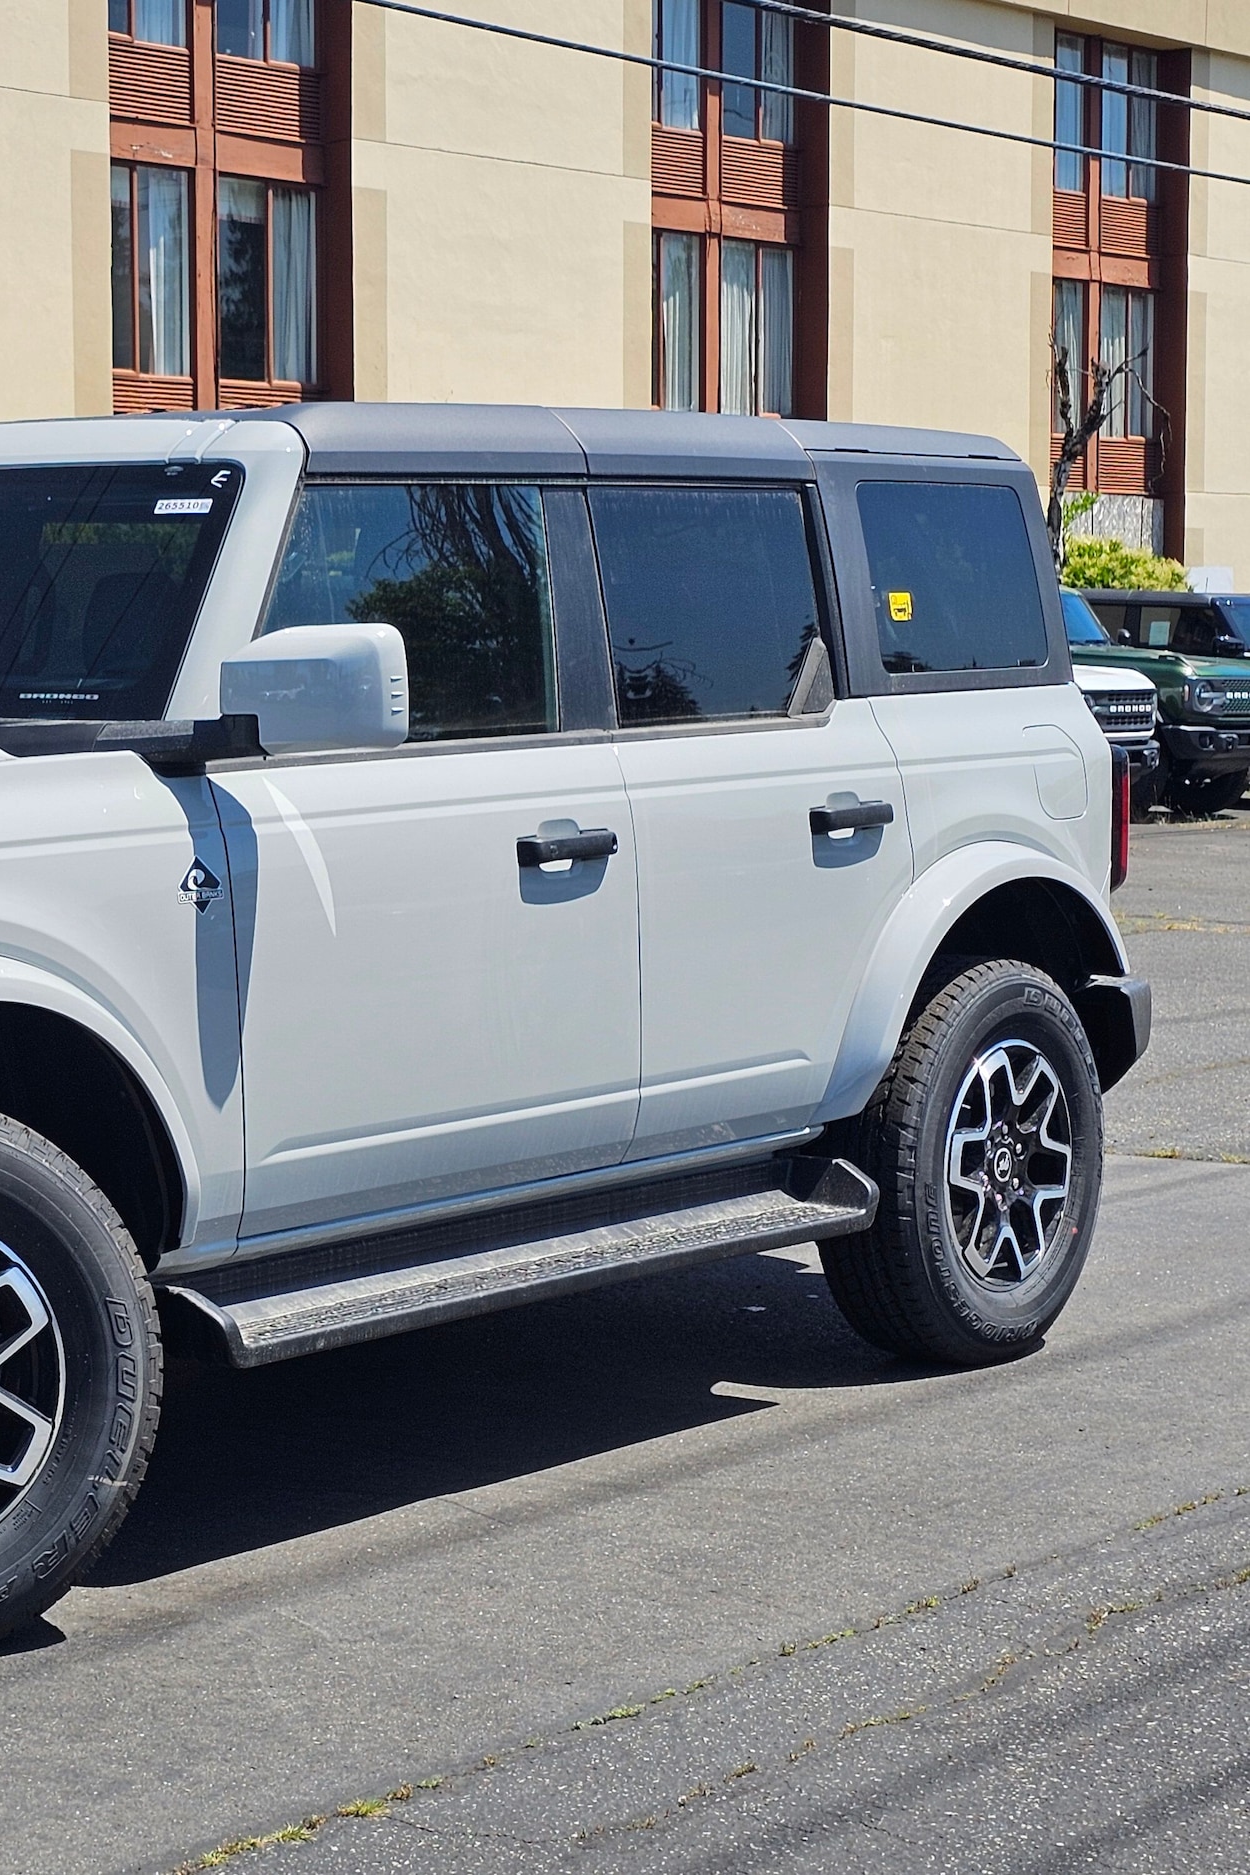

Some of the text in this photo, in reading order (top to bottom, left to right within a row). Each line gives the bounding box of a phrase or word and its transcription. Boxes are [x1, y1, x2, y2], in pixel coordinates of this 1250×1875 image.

[1226, 691, 1250, 699] BRO
[180, 889, 223, 902] OUTER BANKS
[924, 1182, 1041, 1343] BRIDGESTONE
[31, 1296, 138, 1581] DUELER
